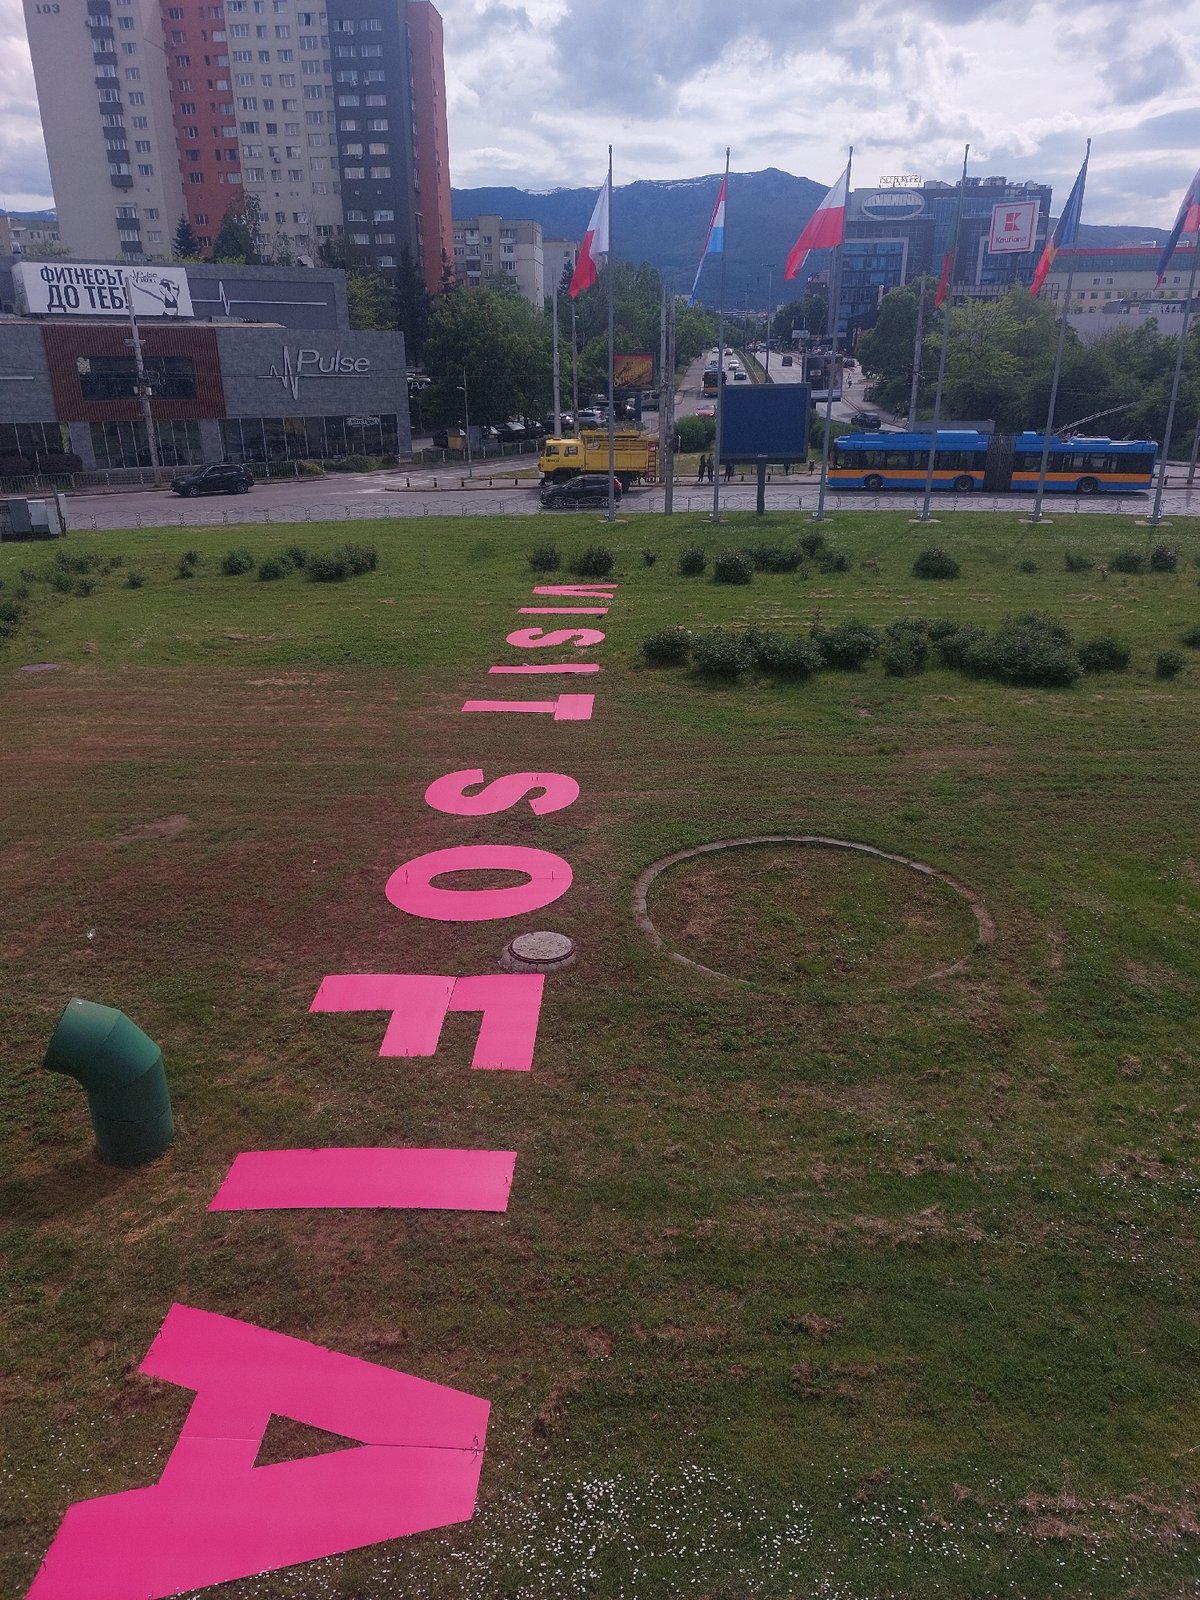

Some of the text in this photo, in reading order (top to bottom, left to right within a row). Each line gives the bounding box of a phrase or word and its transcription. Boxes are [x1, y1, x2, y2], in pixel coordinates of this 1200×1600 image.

[35, 3, 60, 14] 103
[995, 236, 1026, 244] Kaufland
[40, 265, 124, 286] ФИТНЕСЪТ
[47, 285, 129, 312] ДО ТЕБ!
[297, 349, 371, 373] Pulse
[26, 583, 617, 1600] VISIT SOFIA
